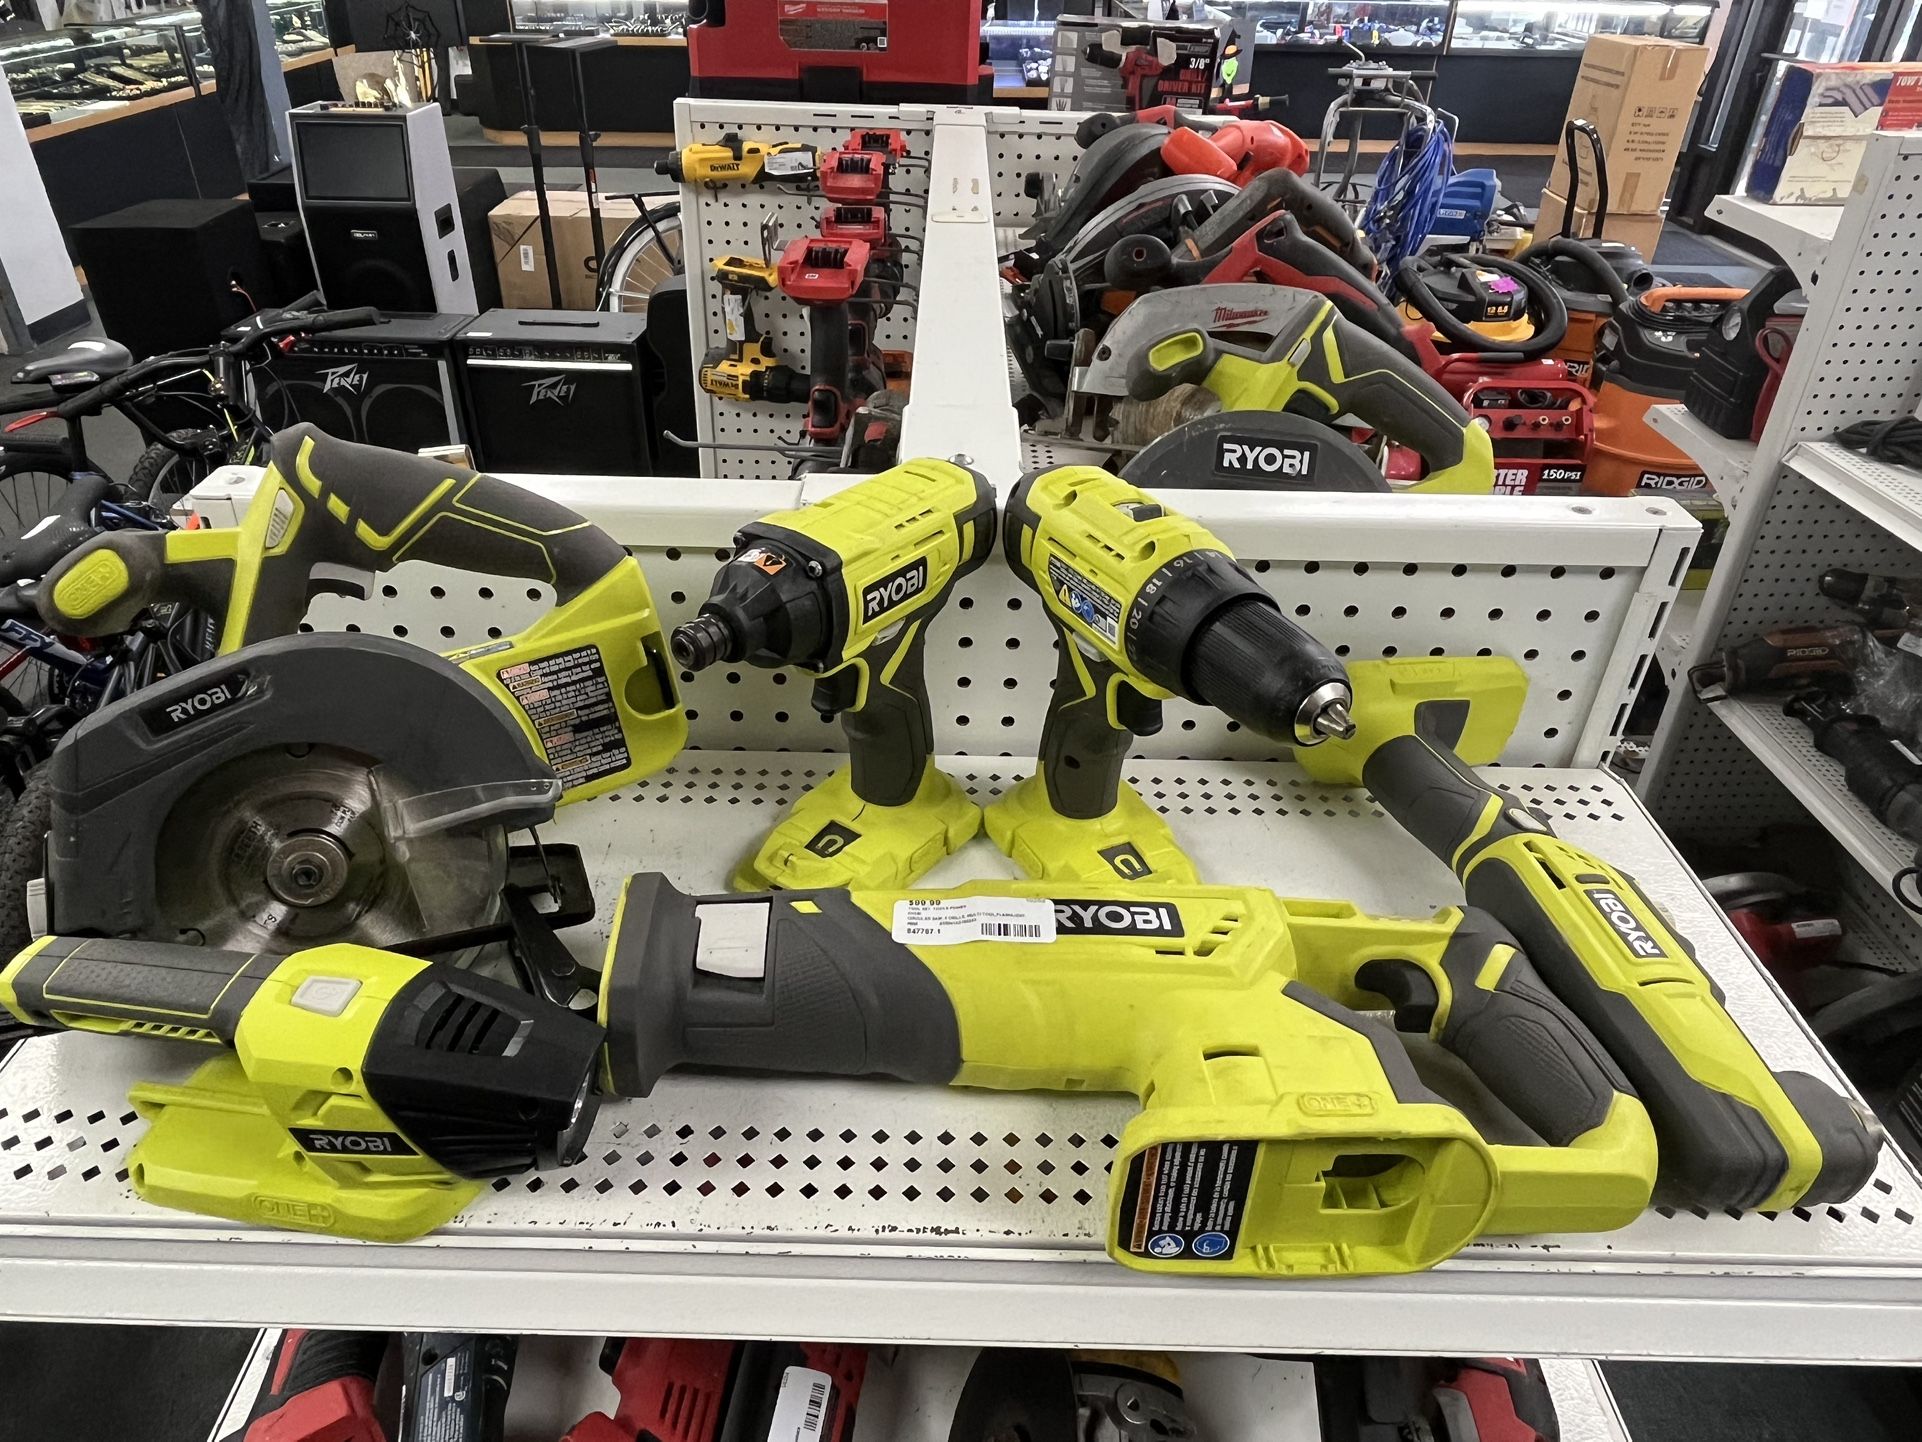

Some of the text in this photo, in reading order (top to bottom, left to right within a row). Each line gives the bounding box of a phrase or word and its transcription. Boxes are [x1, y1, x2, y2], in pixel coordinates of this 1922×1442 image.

[1222, 442, 1311, 477] RYOBI
[1541, 468, 1582, 480] 150 PSI
[1640, 474, 1706, 489] RIDGID
[866, 565, 923, 617] RYOBI
[1145, 578, 1163, 594] 18
[1129, 607, 1142, 630] 20
[165, 684, 232, 722] RYOBI
[1054, 904, 1172, 931] RYOBI
[1592, 893, 1661, 956] RYOBI
[308, 1134, 392, 1152] RYOBI
